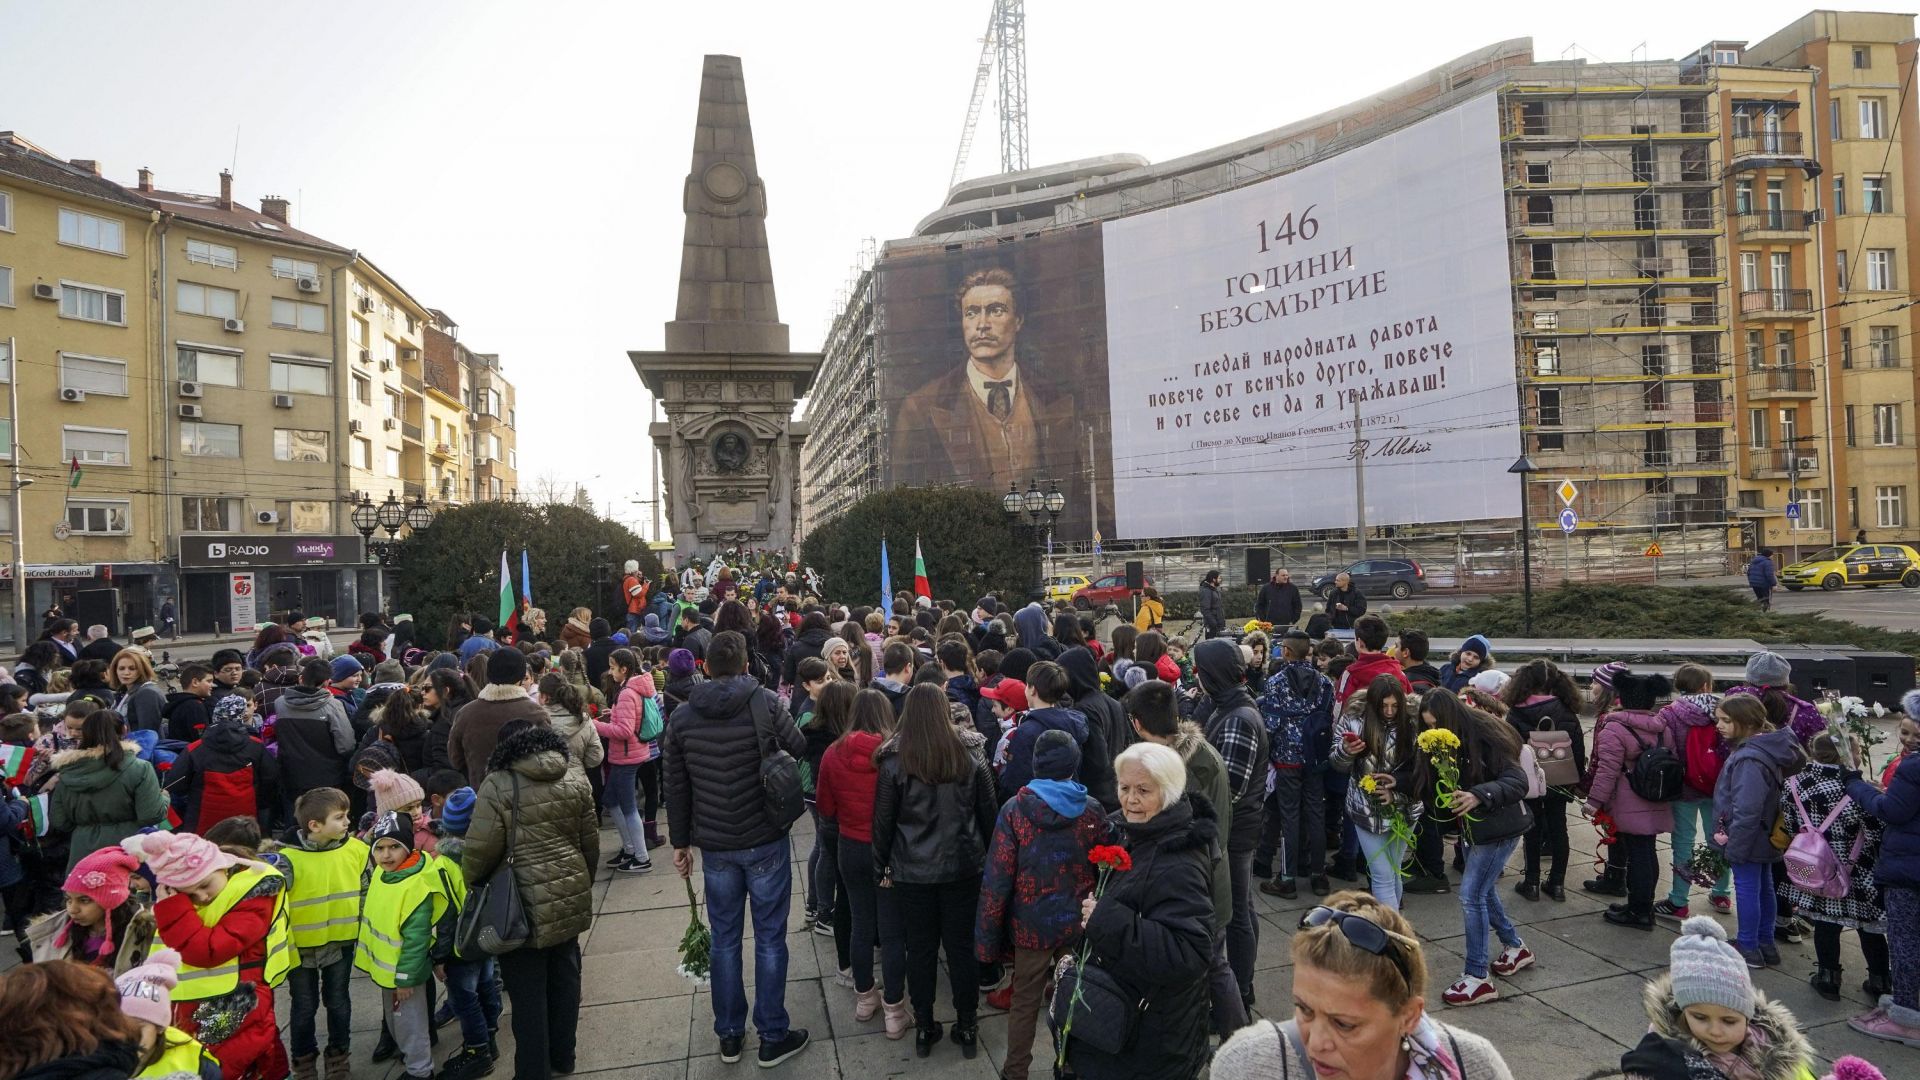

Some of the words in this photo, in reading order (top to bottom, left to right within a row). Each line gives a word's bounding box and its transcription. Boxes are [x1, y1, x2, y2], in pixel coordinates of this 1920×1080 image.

[1257, 204, 1319, 253] 146
[1225, 246, 1353, 297] ГОДИНИ
[1200, 270, 1388, 333] БЕЗСМЪРТИЕ
[1149, 388, 1203, 408] повече
[1216, 383, 1232, 399] от
[1245, 368, 1304, 394] всичко
[1316, 359, 1373, 387] друго,
[1384, 341, 1453, 370] повече
[1194, 352, 1250, 378] гледай
[1264, 336, 1356, 370] народната
[1370, 315, 1438, 350] работа
[1156, 415, 1164, 430] и
[1175, 413, 1192, 427] от
[1204, 405, 1240, 425] себе
[1252, 402, 1271, 417] си
[1284, 394, 1302, 414] да
[1315, 394, 1324, 409] я
[1338, 366, 1447, 410] уважаваш!
[228, 546, 269, 555] RADIO
[297, 544, 328, 556] Melody
